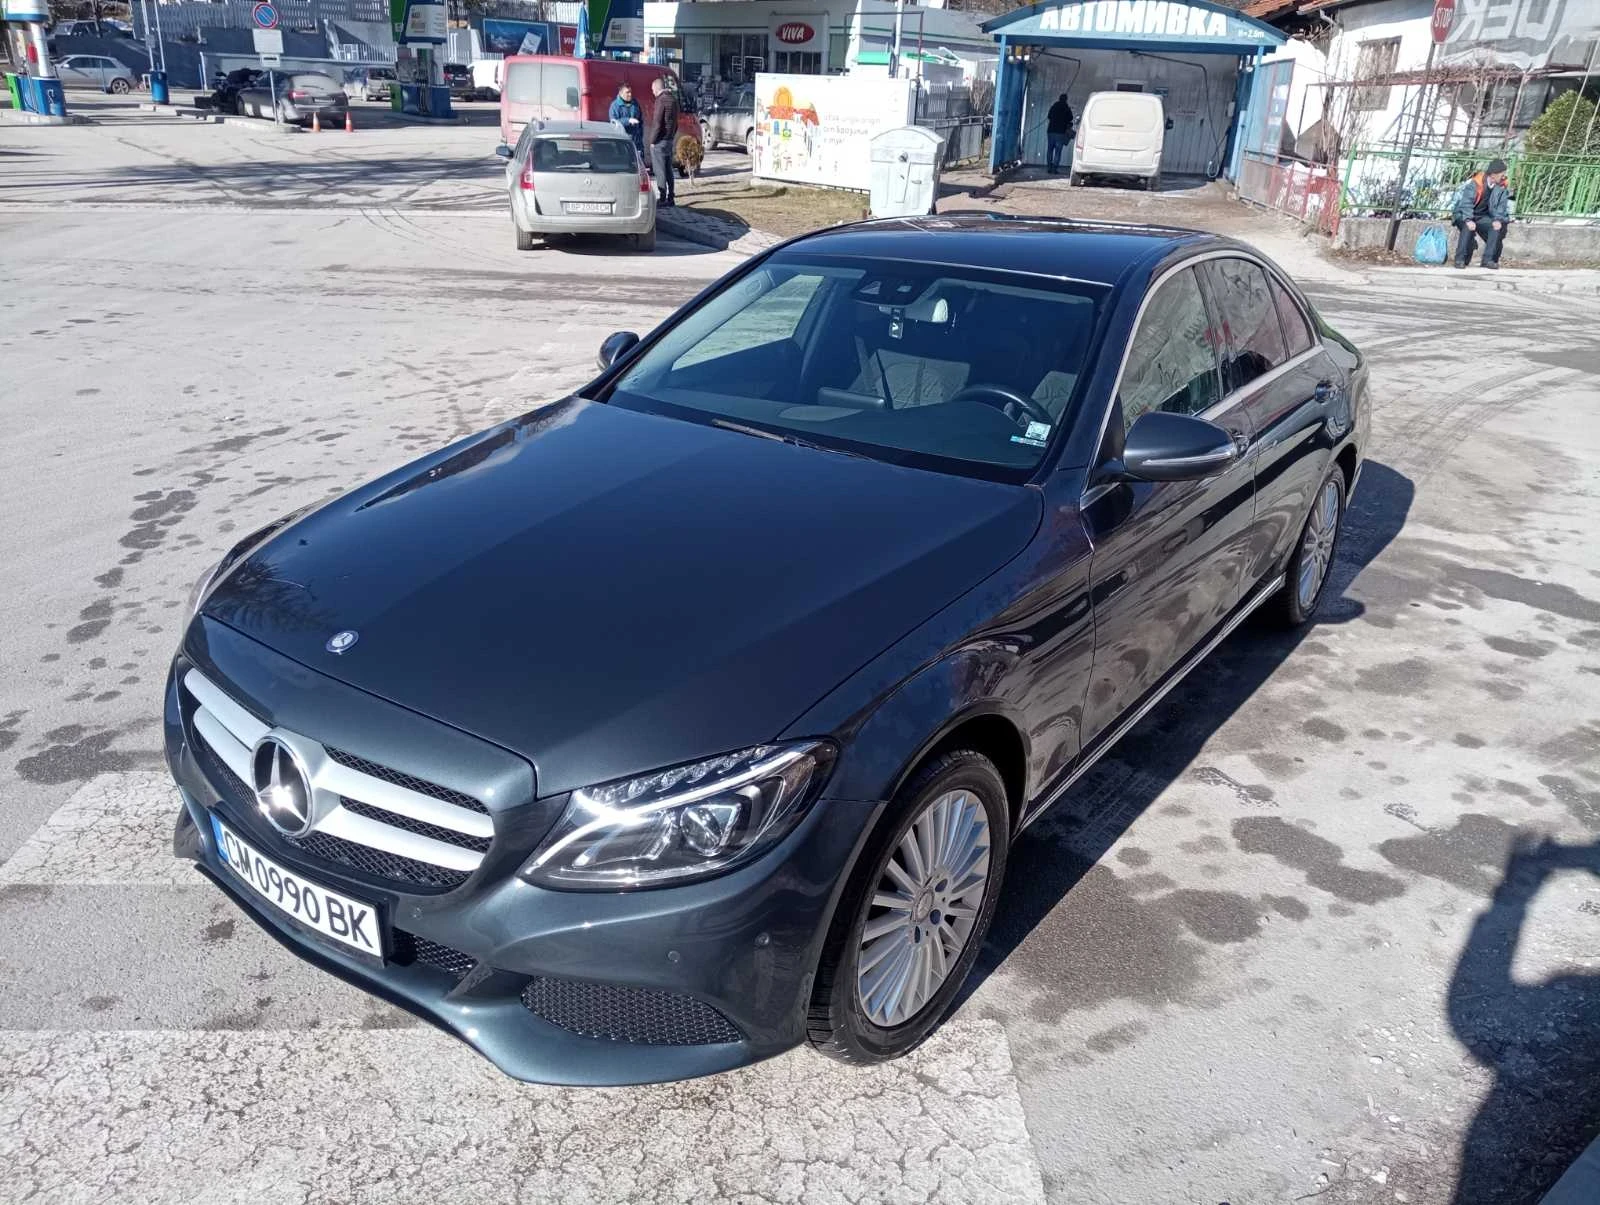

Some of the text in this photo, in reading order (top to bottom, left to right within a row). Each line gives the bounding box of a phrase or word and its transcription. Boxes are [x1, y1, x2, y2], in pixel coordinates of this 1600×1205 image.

[1039, 0, 1228, 37] АВТОМИВКА
[1434, 7, 1453, 28] STOP
[782, 26, 805, 41] VIVA
